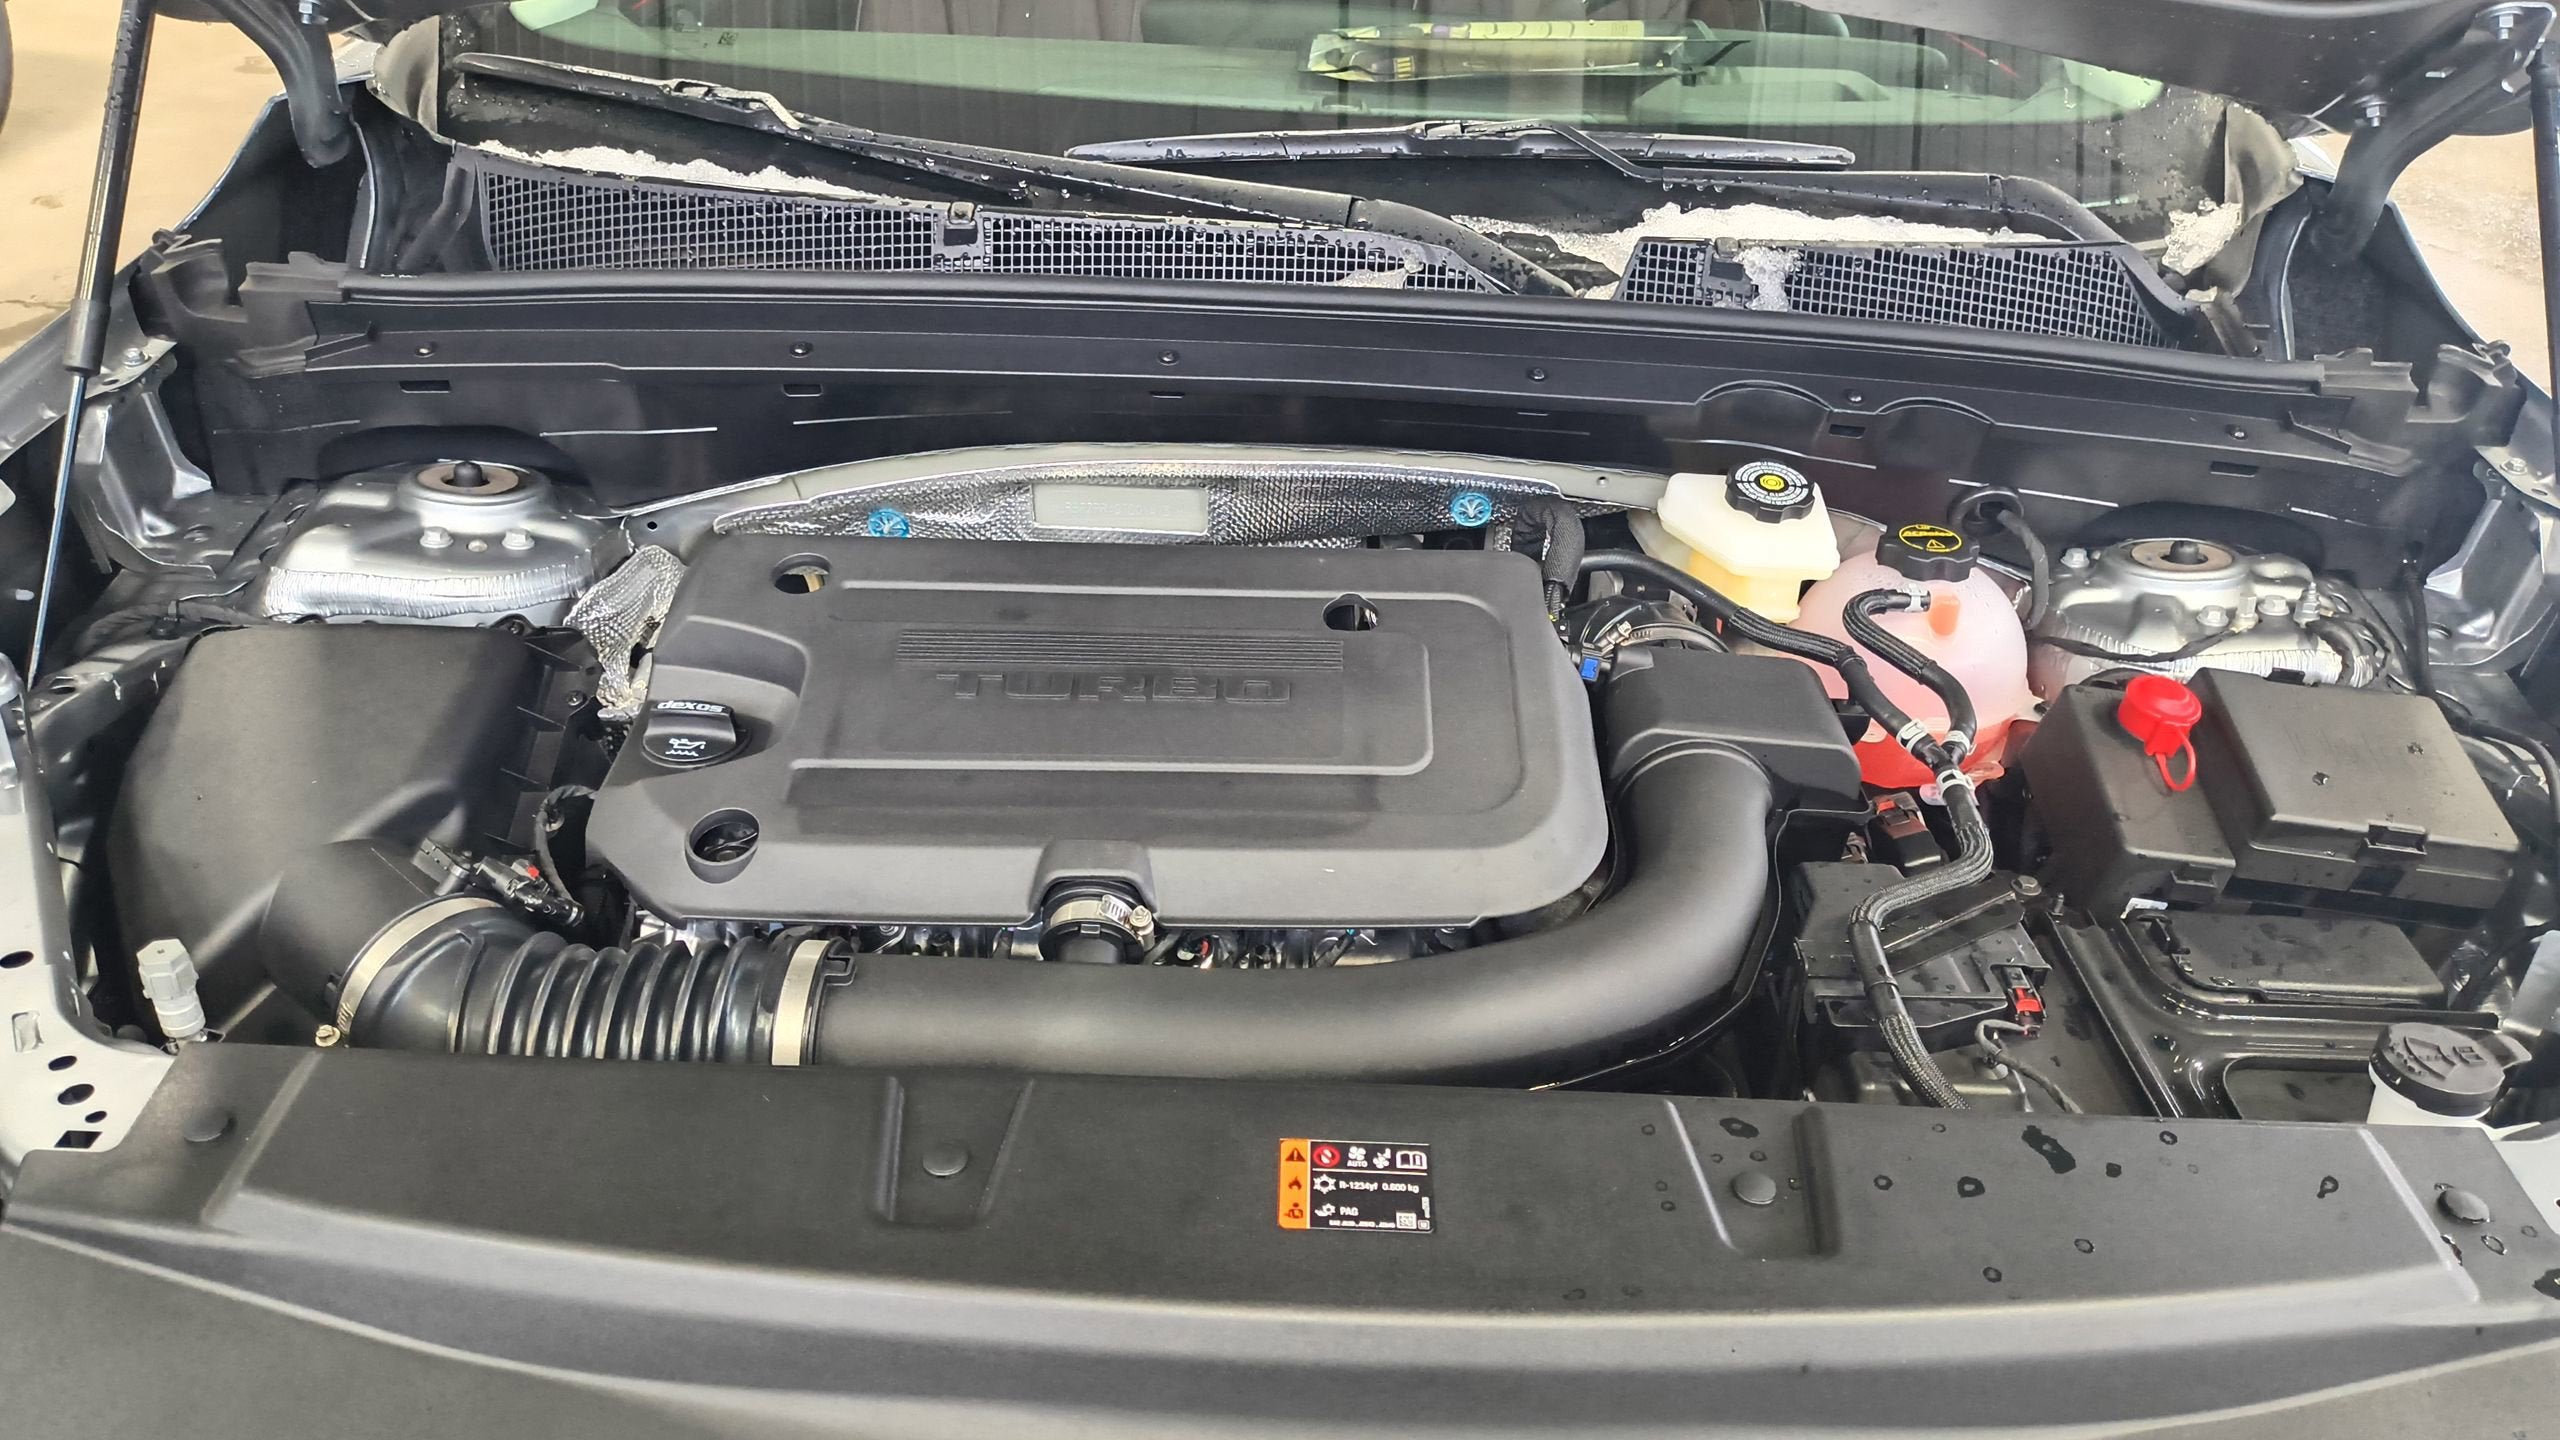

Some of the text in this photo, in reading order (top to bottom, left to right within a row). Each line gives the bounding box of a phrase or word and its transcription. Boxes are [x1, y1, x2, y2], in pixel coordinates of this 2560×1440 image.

[936, 673, 1289, 705] TURBO
[657, 700, 725, 713] dexos
[1408, 1184, 1419, 1193] kg
[1339, 1206, 1359, 1216] PAG
